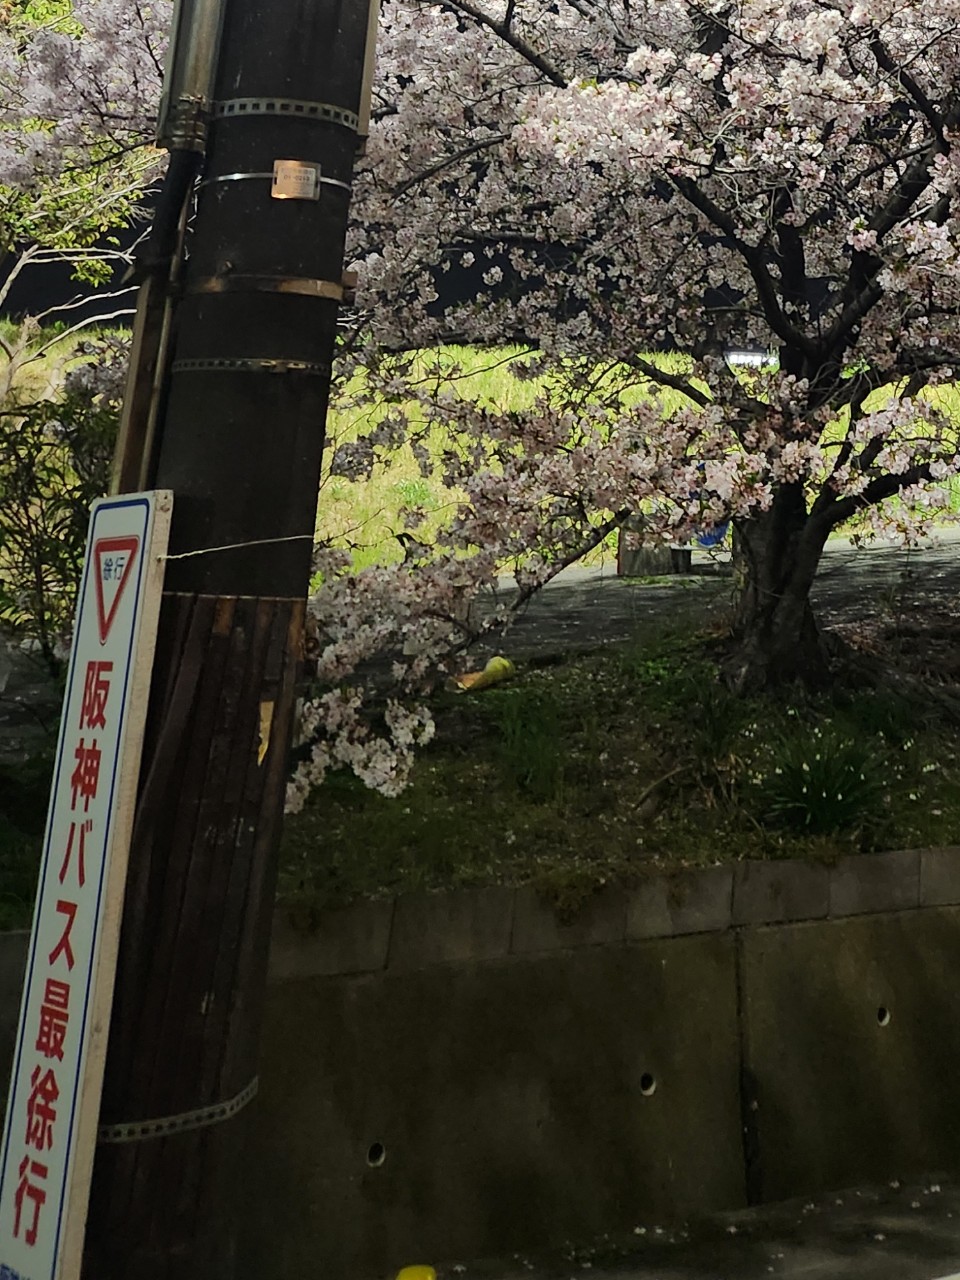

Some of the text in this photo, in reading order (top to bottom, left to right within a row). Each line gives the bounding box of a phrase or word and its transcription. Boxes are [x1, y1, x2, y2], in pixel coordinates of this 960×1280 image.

[13, 661, 113, 1246] 阪神バス最徐行
